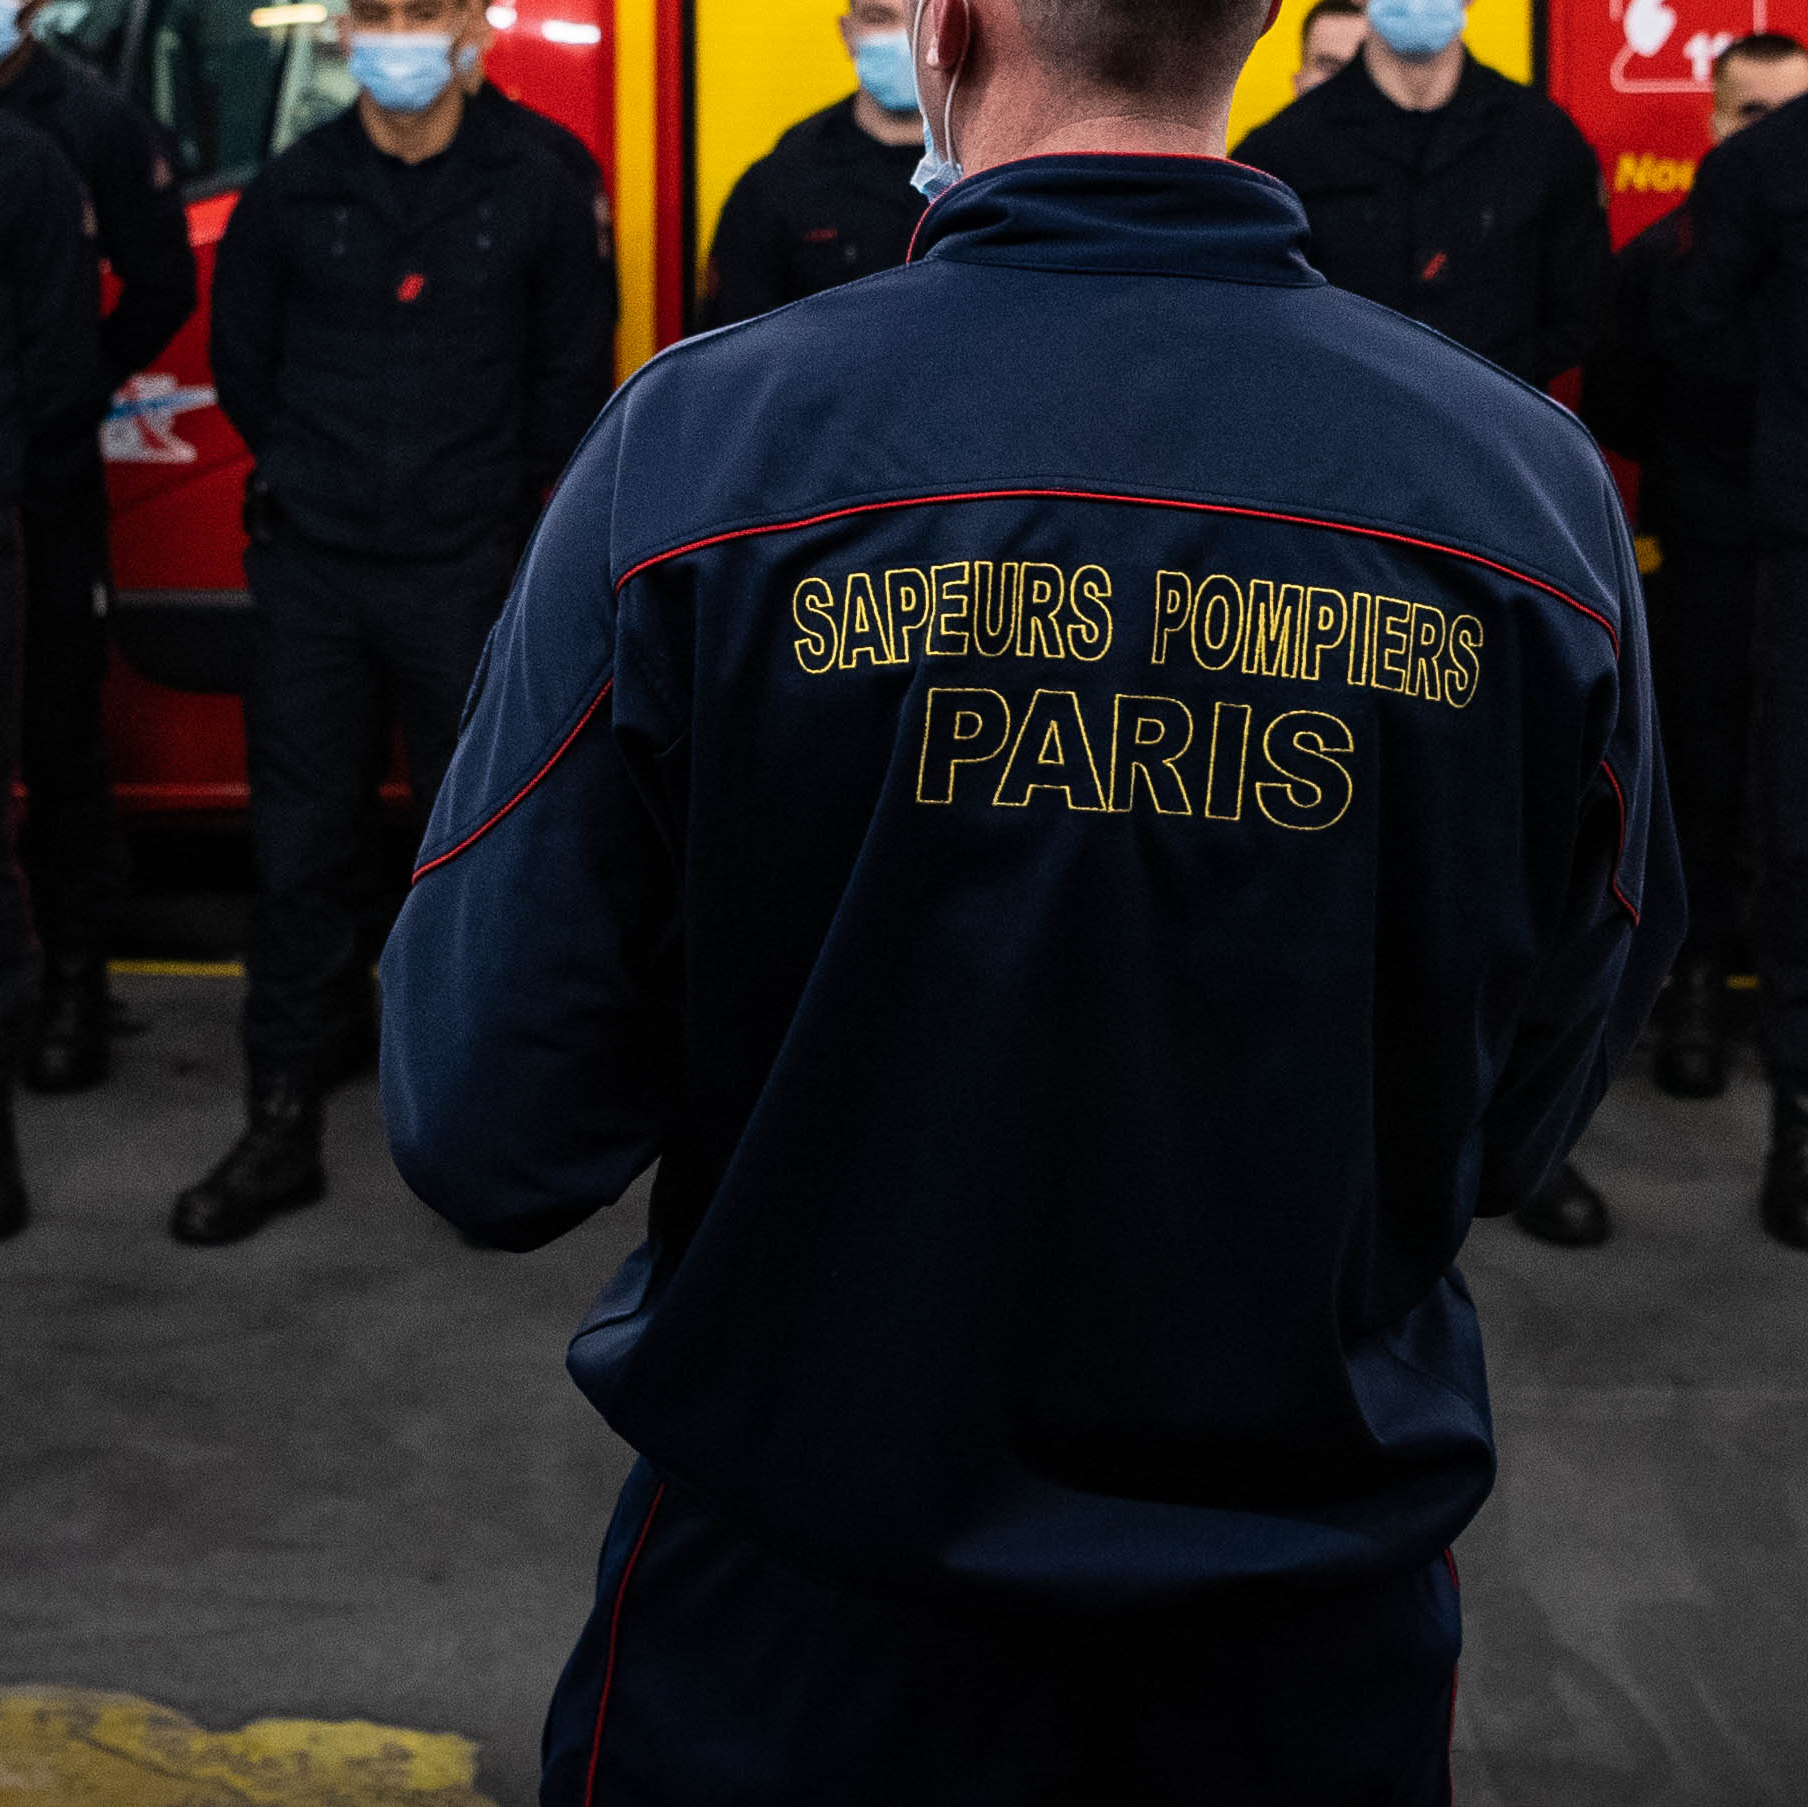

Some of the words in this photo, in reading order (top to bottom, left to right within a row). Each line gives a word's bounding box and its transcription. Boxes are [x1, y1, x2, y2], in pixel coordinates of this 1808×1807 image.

[791, 558, 1114, 676] SAPEURS
[1150, 568, 1486, 709] POMPIERS
[915, 686, 1355, 832] PARIS
